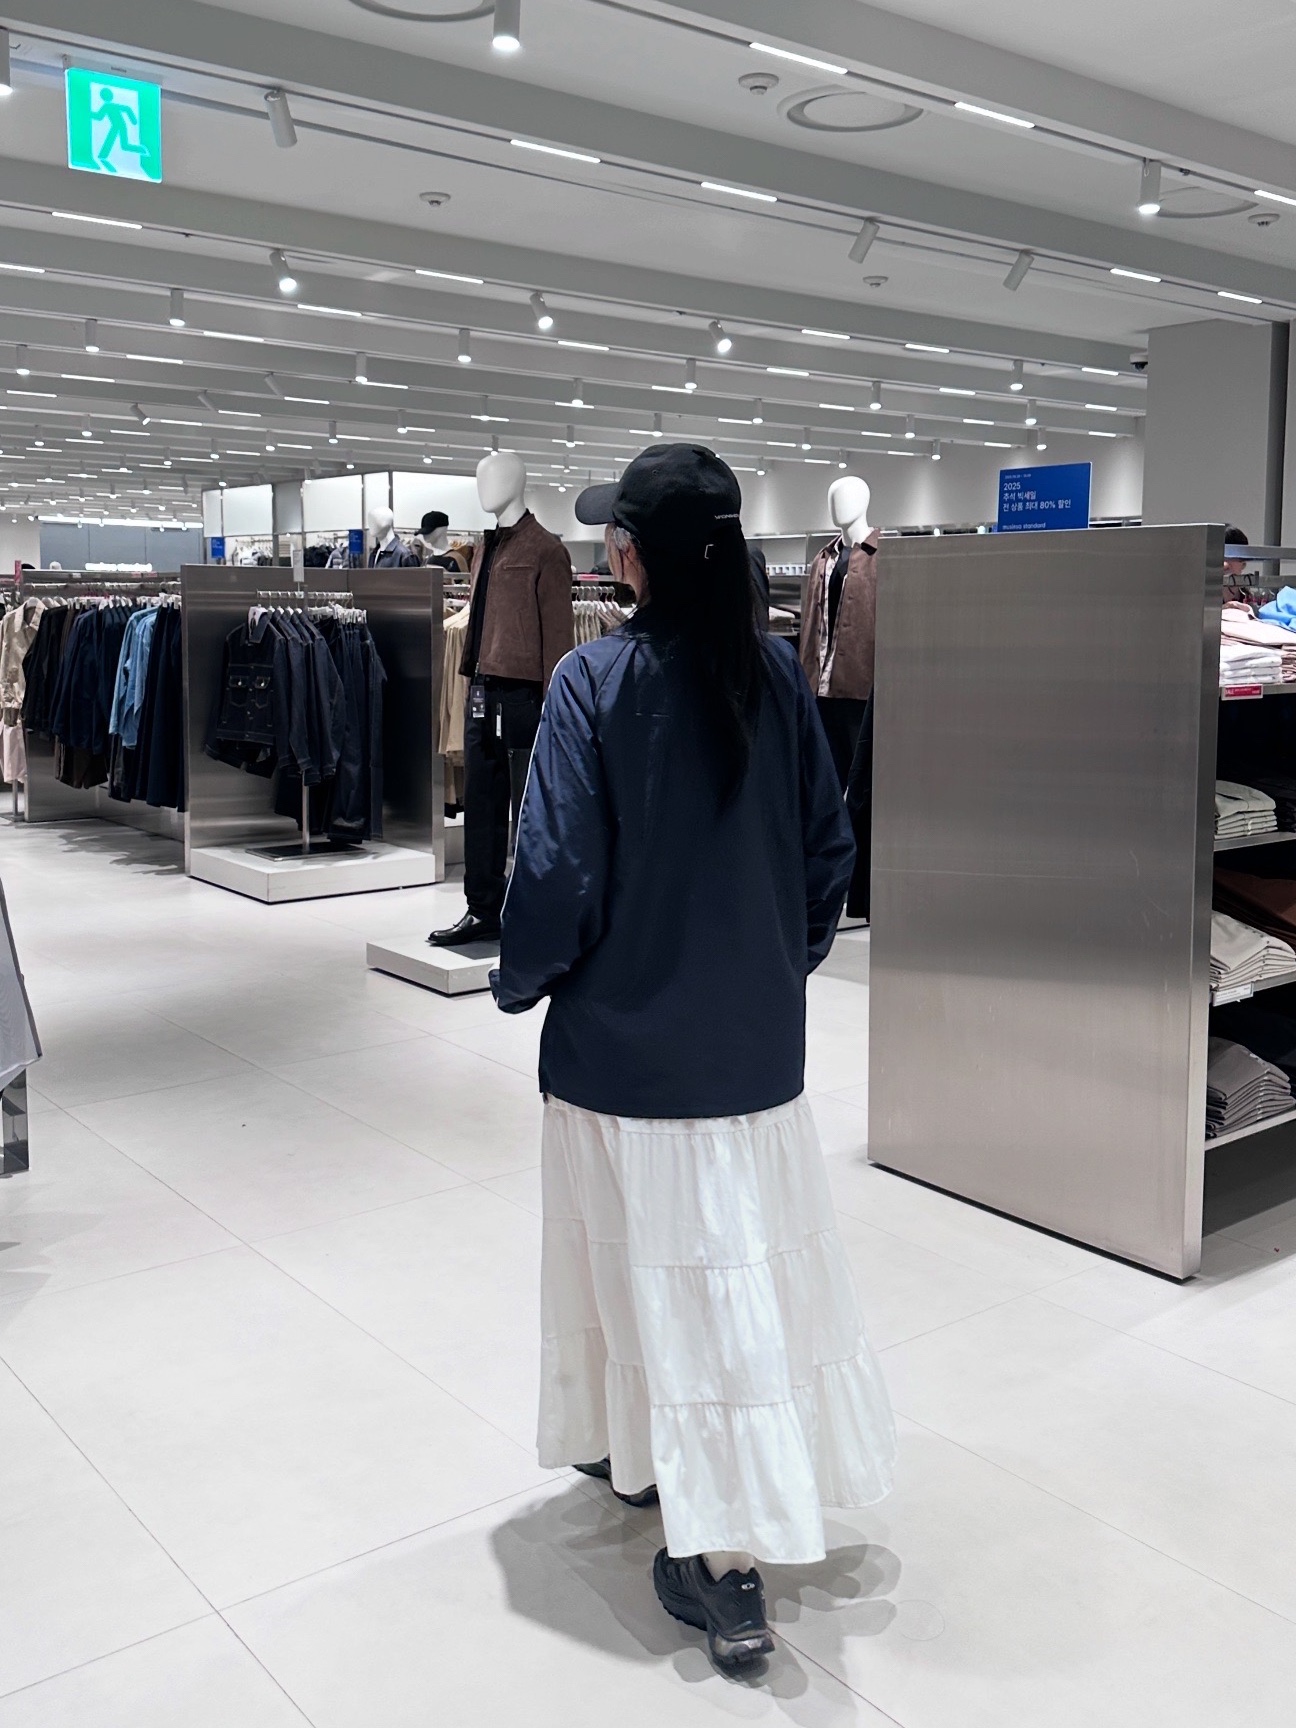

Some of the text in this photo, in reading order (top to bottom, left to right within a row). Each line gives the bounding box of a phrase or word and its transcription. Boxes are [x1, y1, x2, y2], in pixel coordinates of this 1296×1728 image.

[1003, 482, 1021, 491] 2025
[1003, 491, 1037, 501] 추석 빅세일
[1003, 499, 1071, 512] 전 상품 최대 80% 할인
